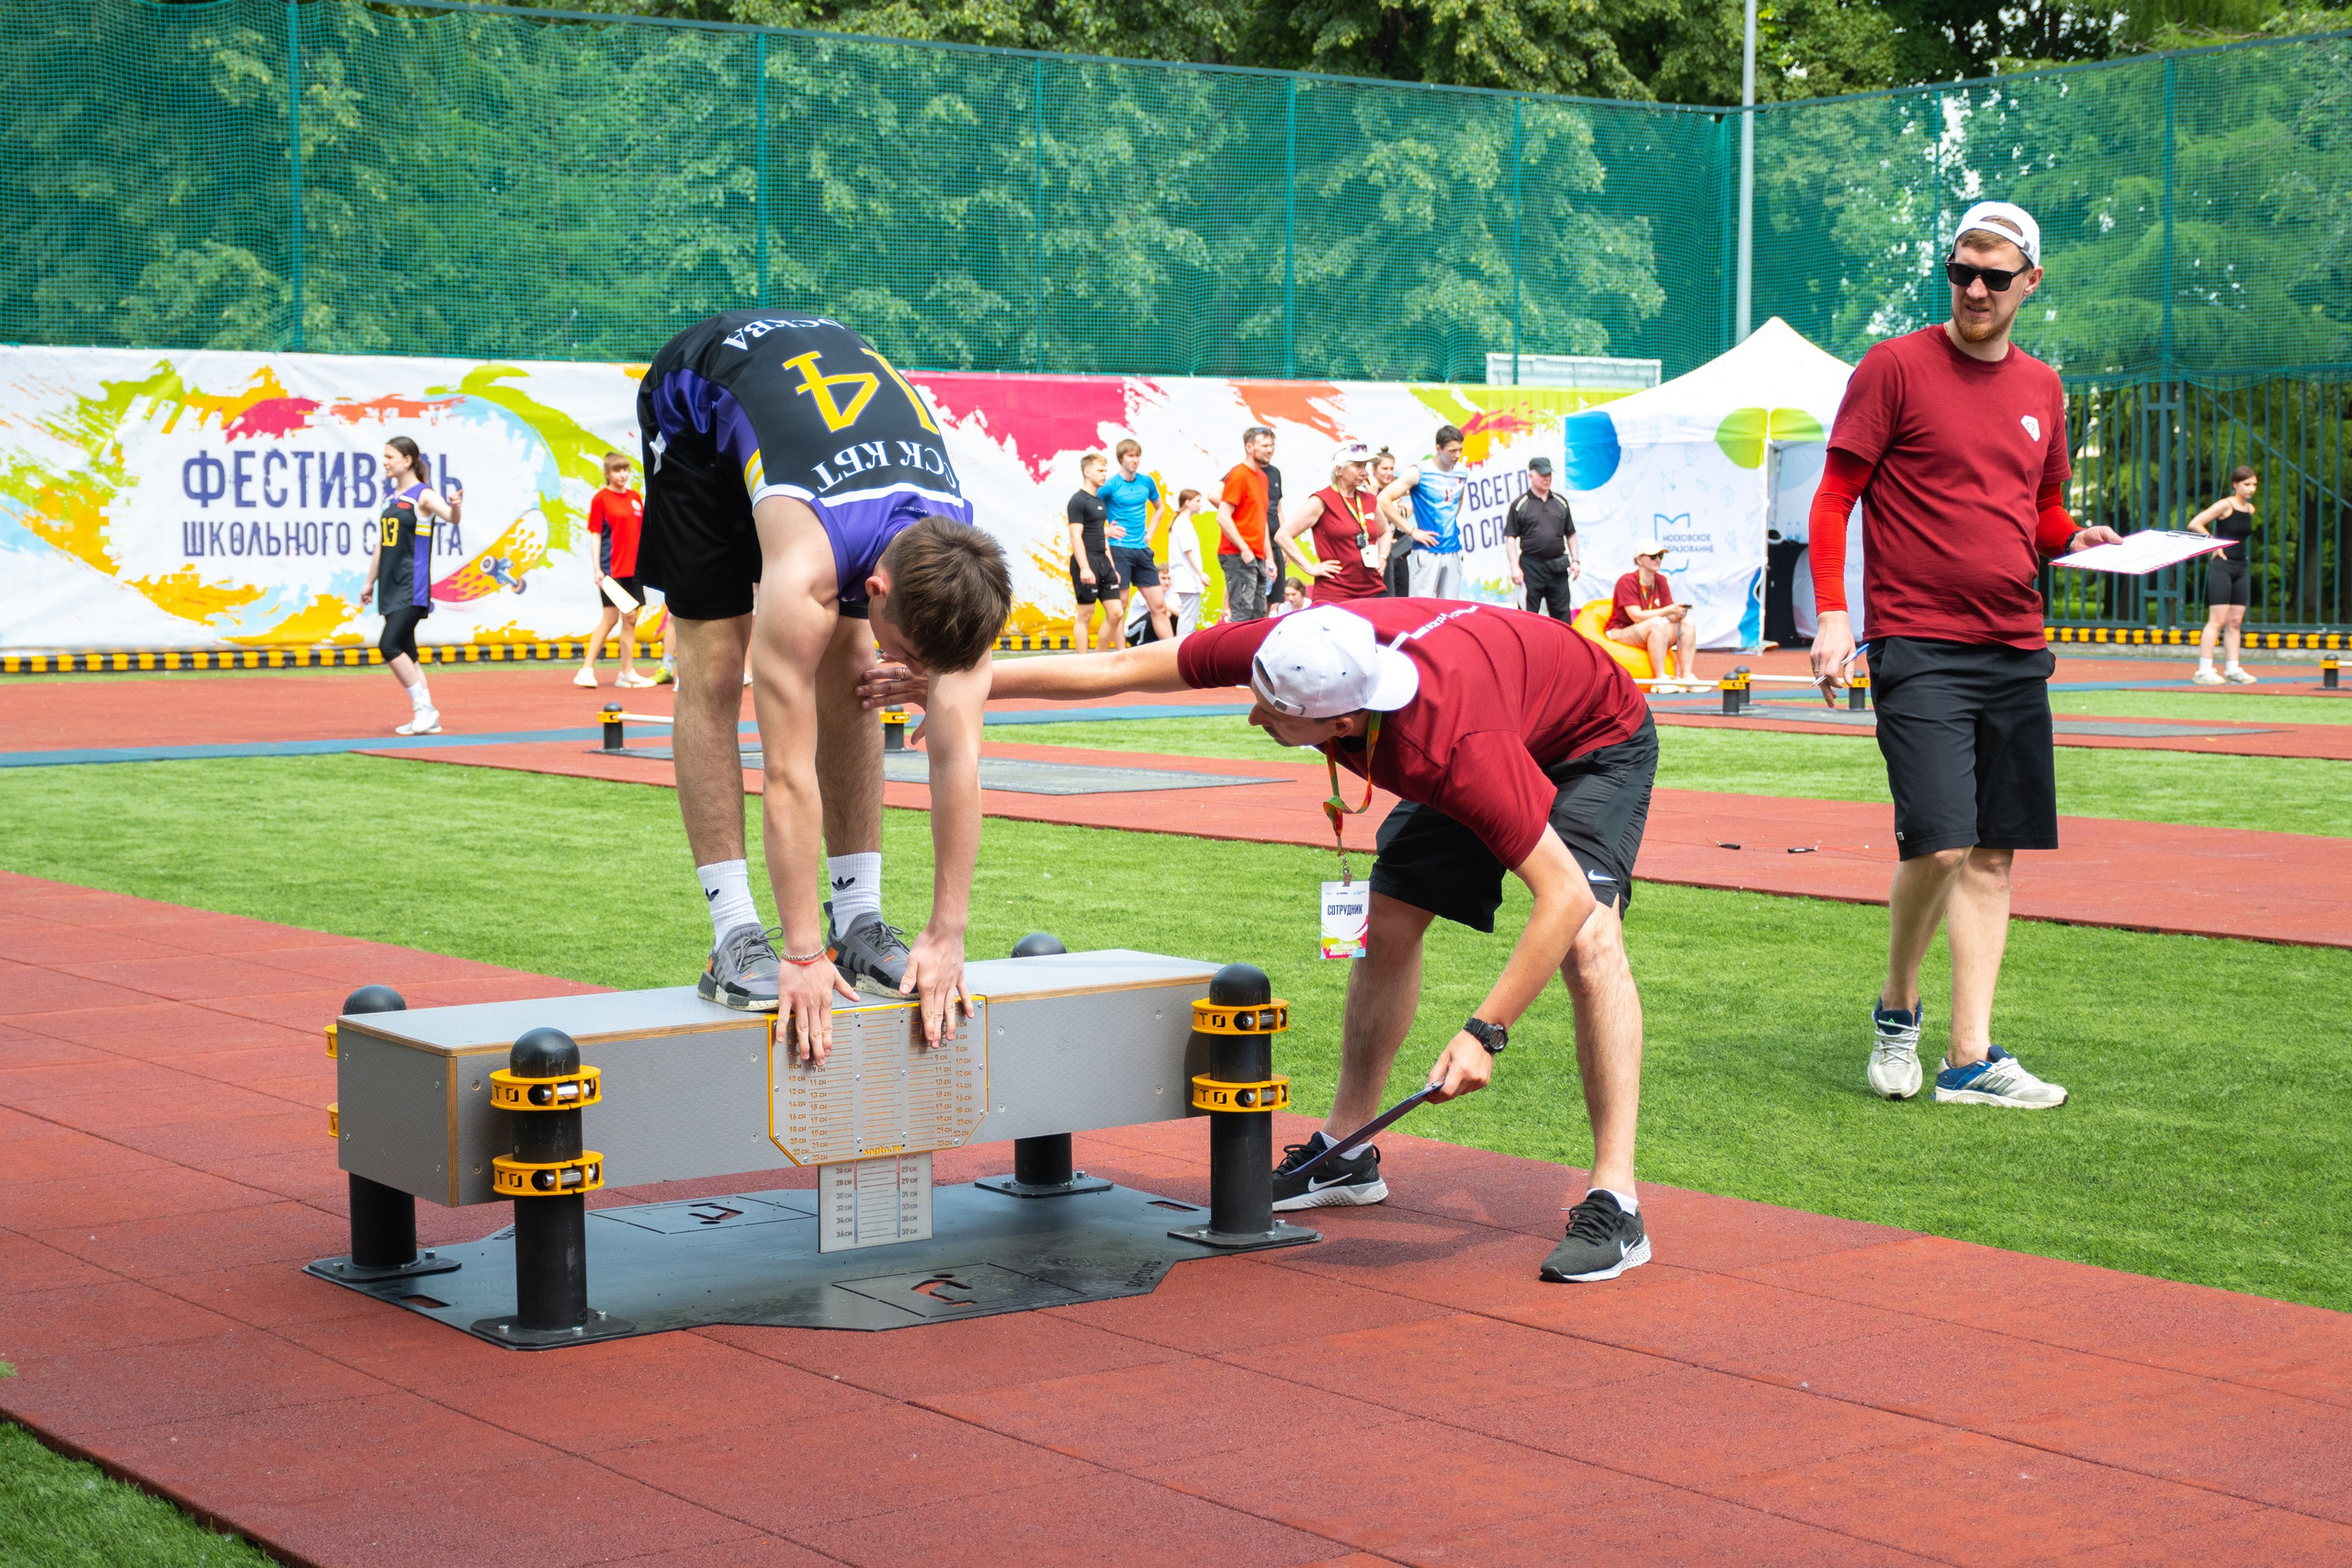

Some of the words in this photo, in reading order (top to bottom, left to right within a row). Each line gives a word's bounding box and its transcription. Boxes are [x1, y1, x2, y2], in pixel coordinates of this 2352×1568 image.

[782, 346, 941, 435] 14
[183, 448, 464, 508] ФЕСТИВЬ
[810, 441, 891, 492] КБТ
[1467, 469, 1530, 512] ВСЕГД
[183, 521, 351, 557] ШКОЛЬНОГО
[363, 521, 463, 557] СТА
[381, 517, 400, 547] 13
[1327, 904, 1363, 917] СОТРУДНИК
